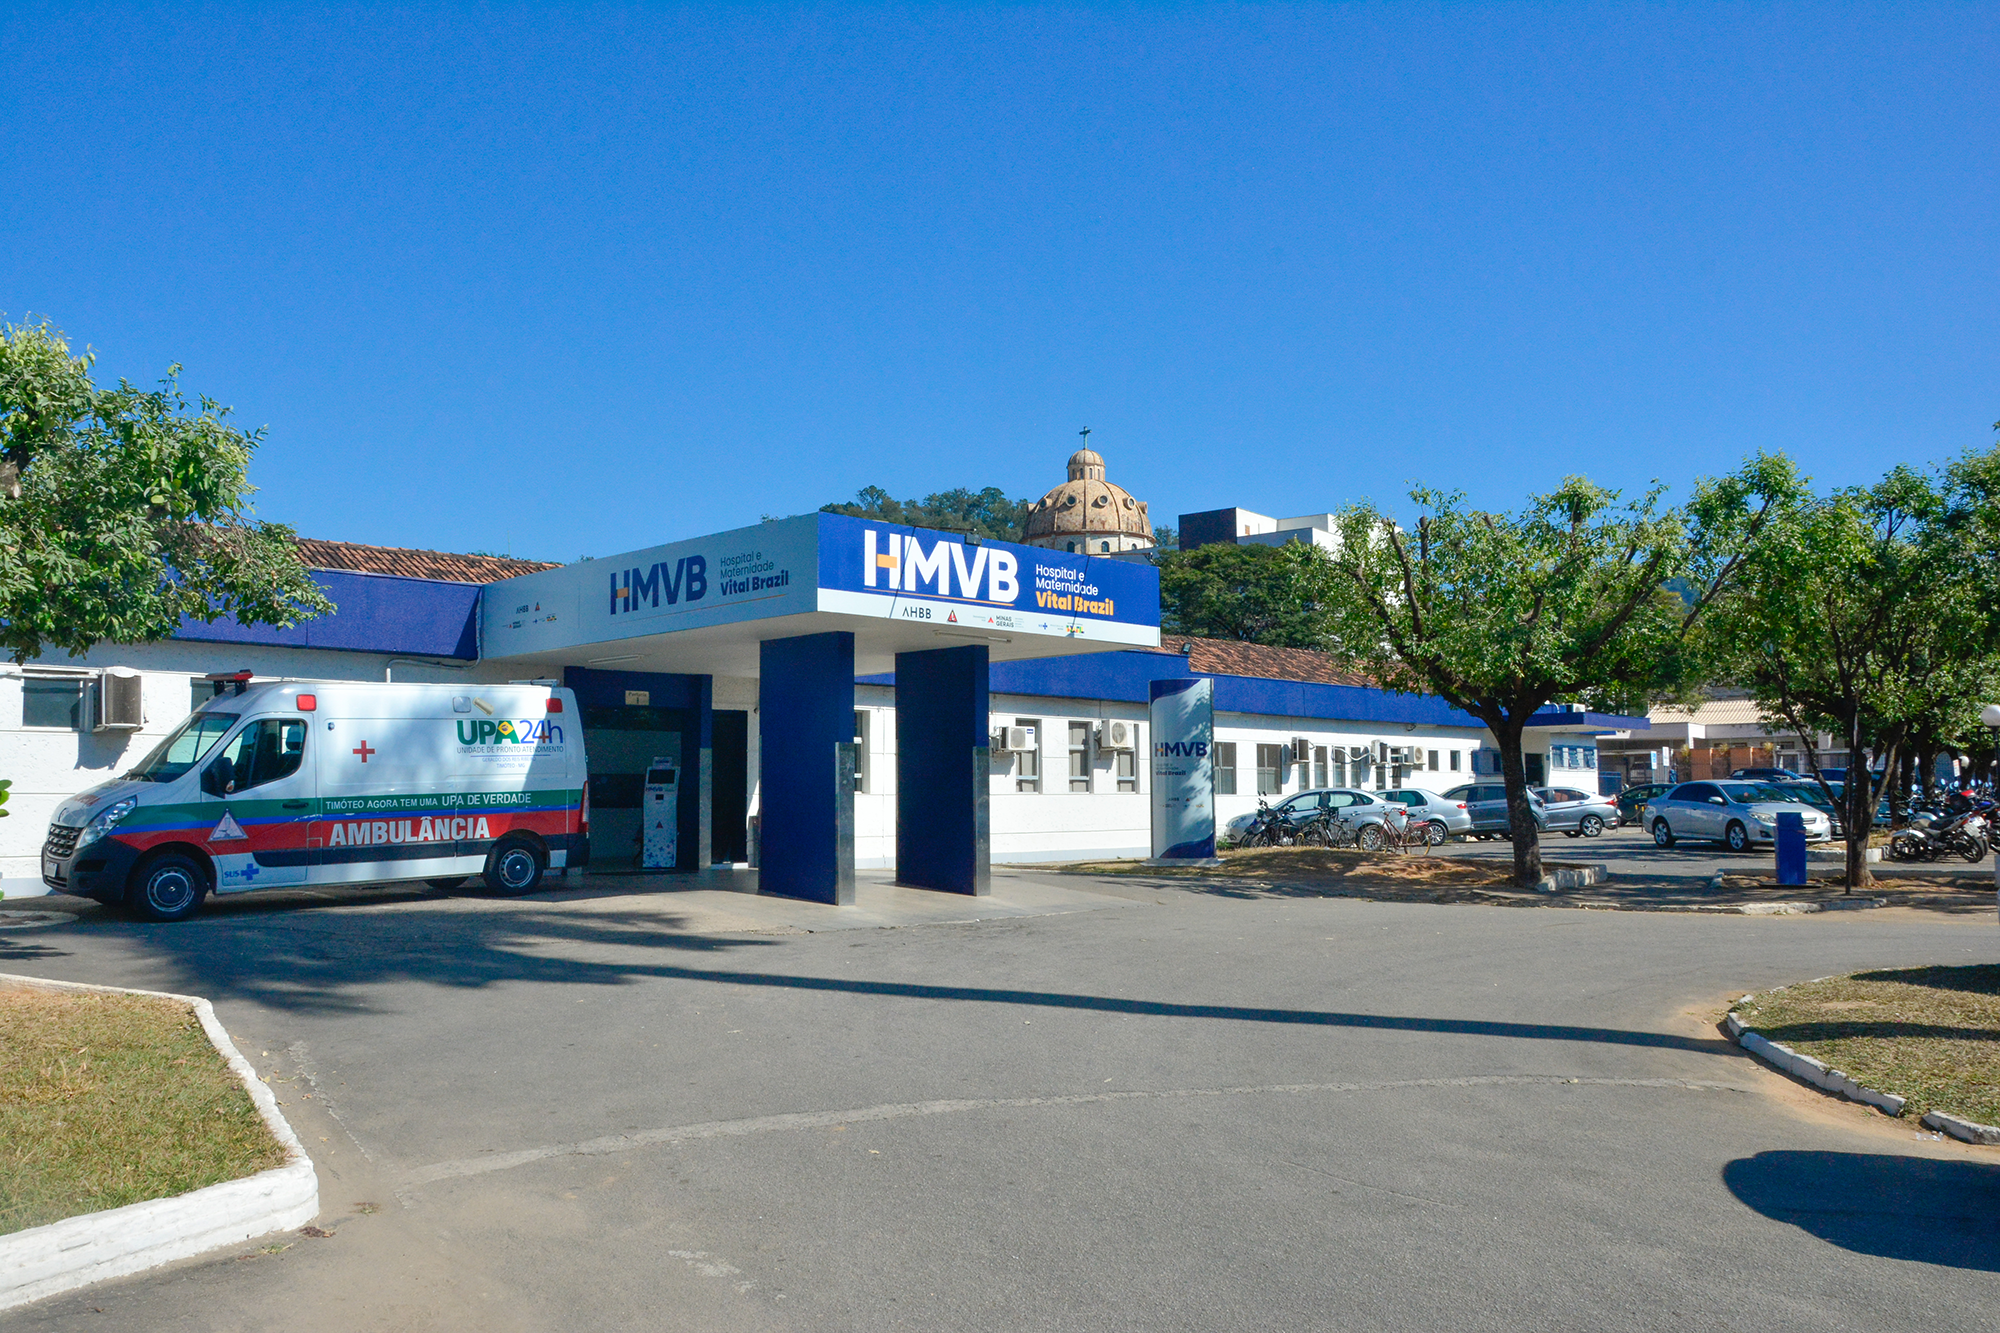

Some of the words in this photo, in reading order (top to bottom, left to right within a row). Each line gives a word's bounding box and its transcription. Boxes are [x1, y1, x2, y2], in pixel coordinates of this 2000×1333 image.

[720, 550, 754, 568] Hospital
[756, 551, 762, 560] e
[864, 529, 1019, 602] HMVB
[720, 560, 774, 579] Maternidade
[1036, 564, 1076, 581] Hospital
[1078, 572, 1085, 582] e
[610, 555, 707, 615] HMVB
[720, 577, 750, 596] Vital
[752, 570, 789, 591] Brazil
[1036, 577, 1098, 596] Maternidade
[902, 606, 932, 619] AHBB
[1036, 590, 1072, 610] Vital
[1074, 596, 1114, 616] Brazil
[1154, 742, 1208, 757] HMVB
[326, 798, 364, 810] TIMÓTEO
[367, 800, 398, 808] AGORA
[420, 798, 438, 806] UMA
[442, 795, 464, 806] UPA
[468, 794, 480, 805] DE
[483, 793, 532, 804] VERDADE
[329, 816, 490, 846] AMBULÂNCIA
[224, 870, 240, 878] SUS
